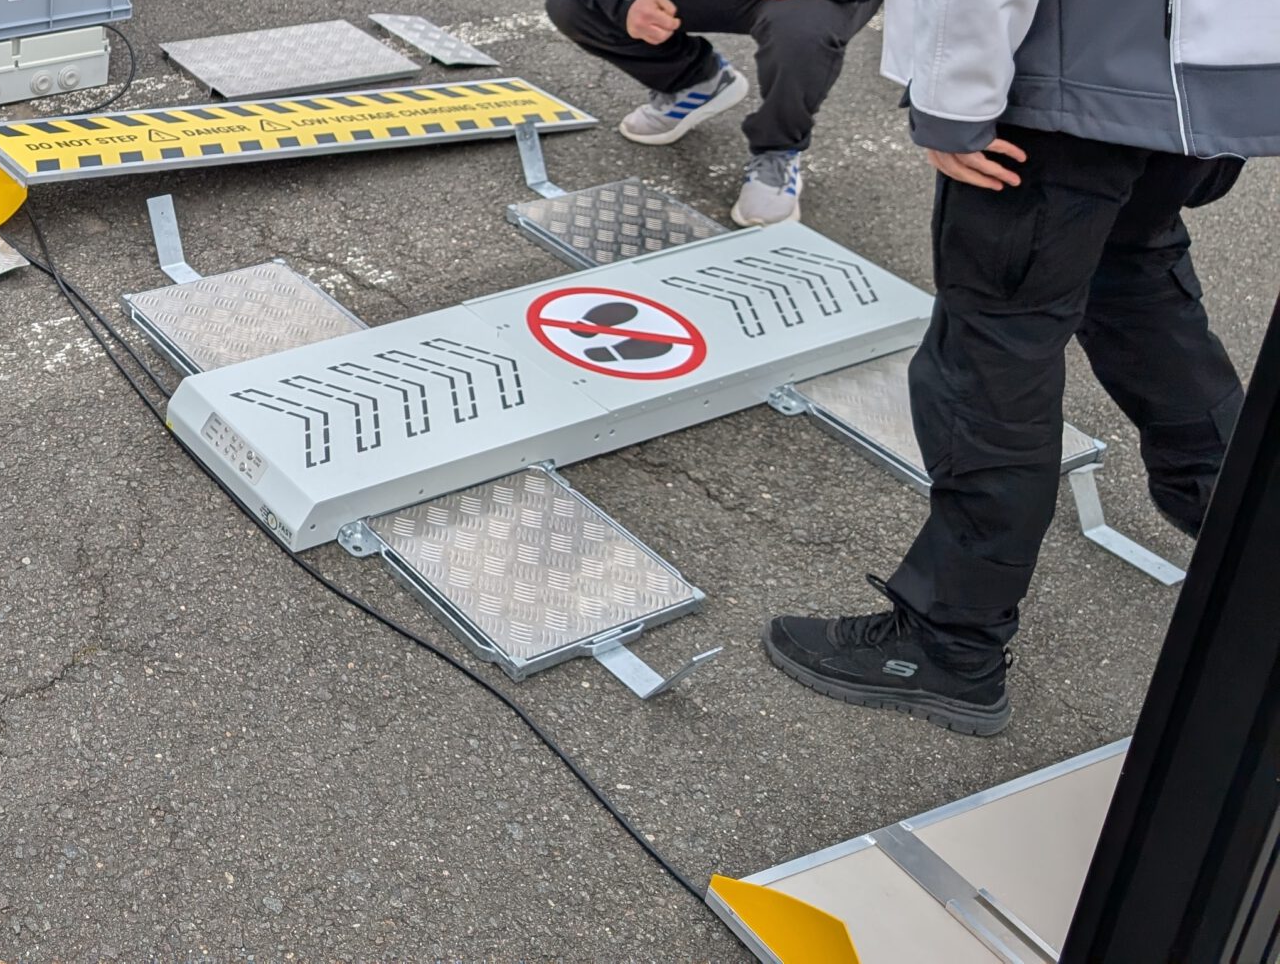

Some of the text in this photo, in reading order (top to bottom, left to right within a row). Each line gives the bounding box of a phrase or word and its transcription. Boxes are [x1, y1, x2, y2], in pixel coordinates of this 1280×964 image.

[25, 98, 537, 152] DO NOT STEP DANGER LOW VOLTAGE CHARGING STATION
